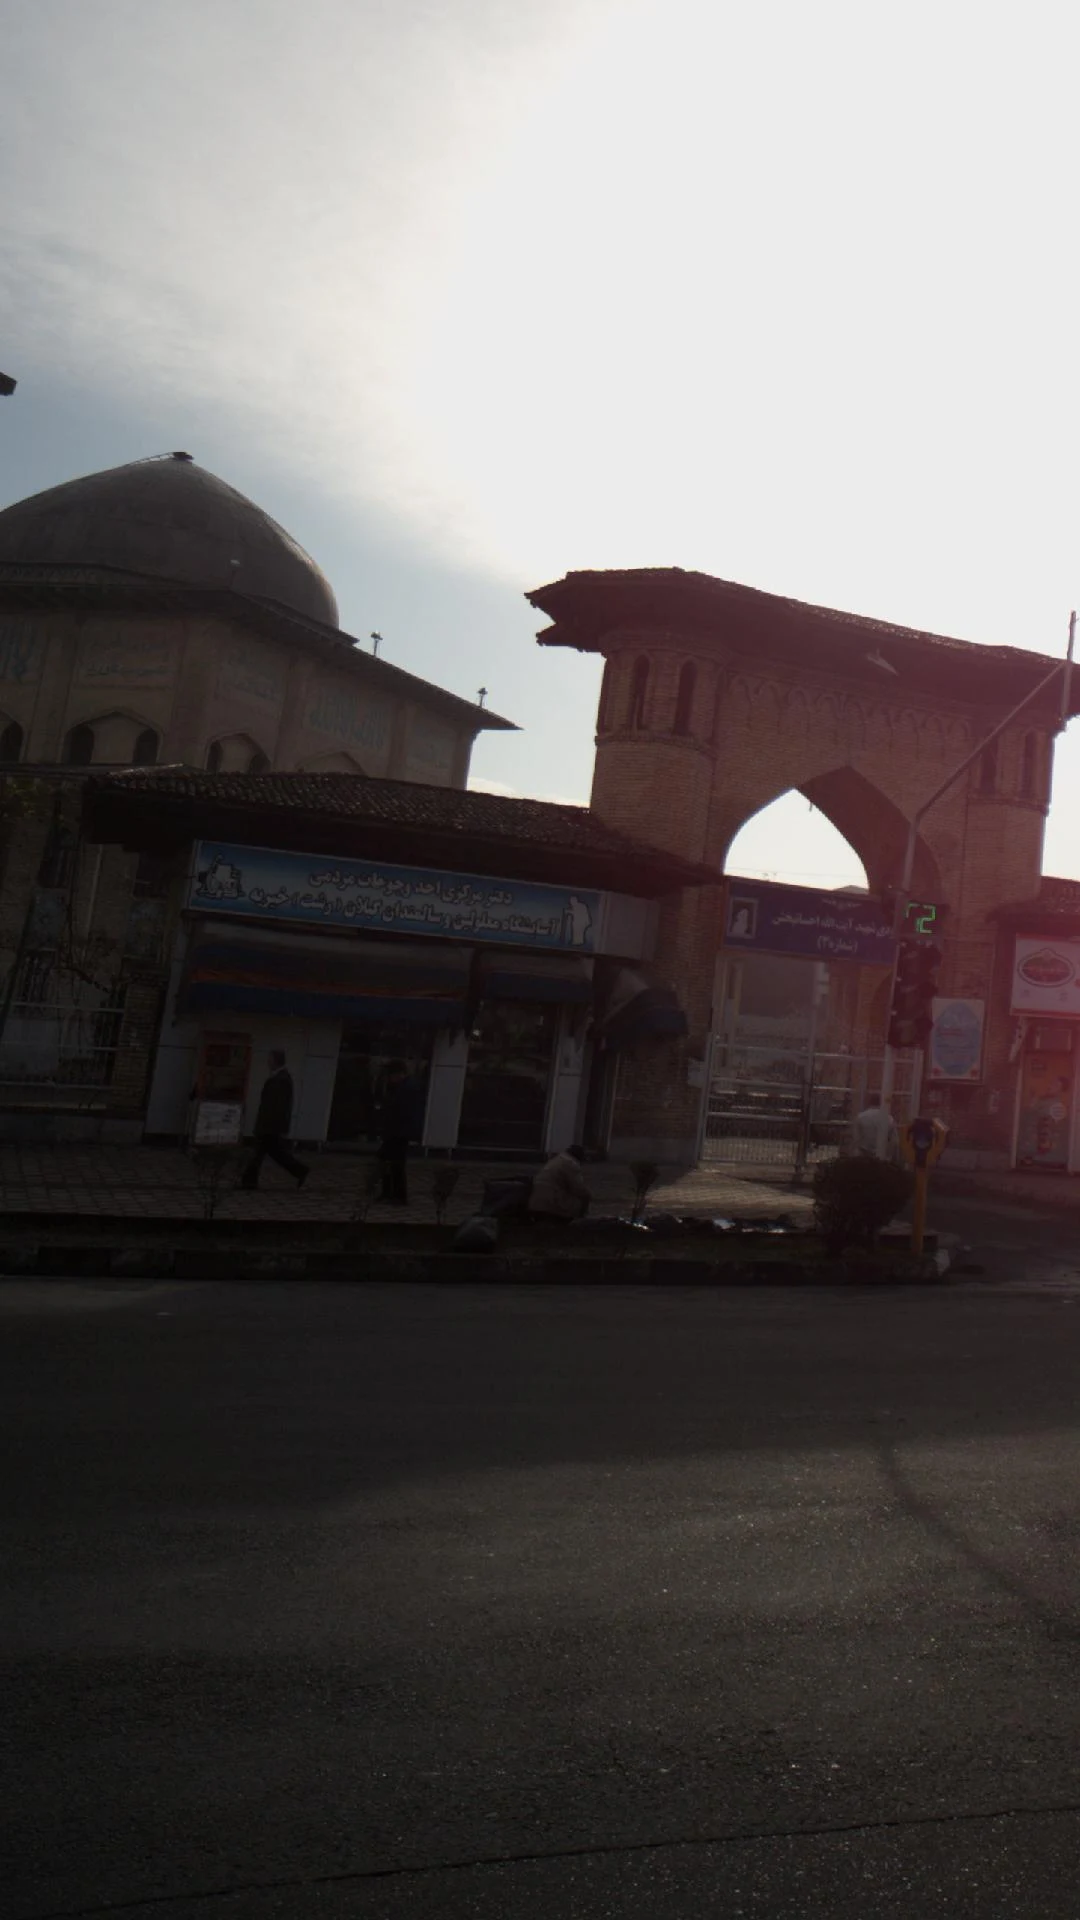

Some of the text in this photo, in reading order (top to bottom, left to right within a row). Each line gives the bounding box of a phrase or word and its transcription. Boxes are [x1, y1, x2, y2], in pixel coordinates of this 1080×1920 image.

[309, 869, 355, 890] مردمی
[249, 885, 289, 910] خیریه
[441, 883, 484, 905] مرکزی
[486, 887, 514, 907] دفتر
[343, 894, 383, 918] گیلان
[382, 901, 441, 923] سالمندان
[443, 912, 452, 930] و
[452, 907, 501, 934] معلولین
